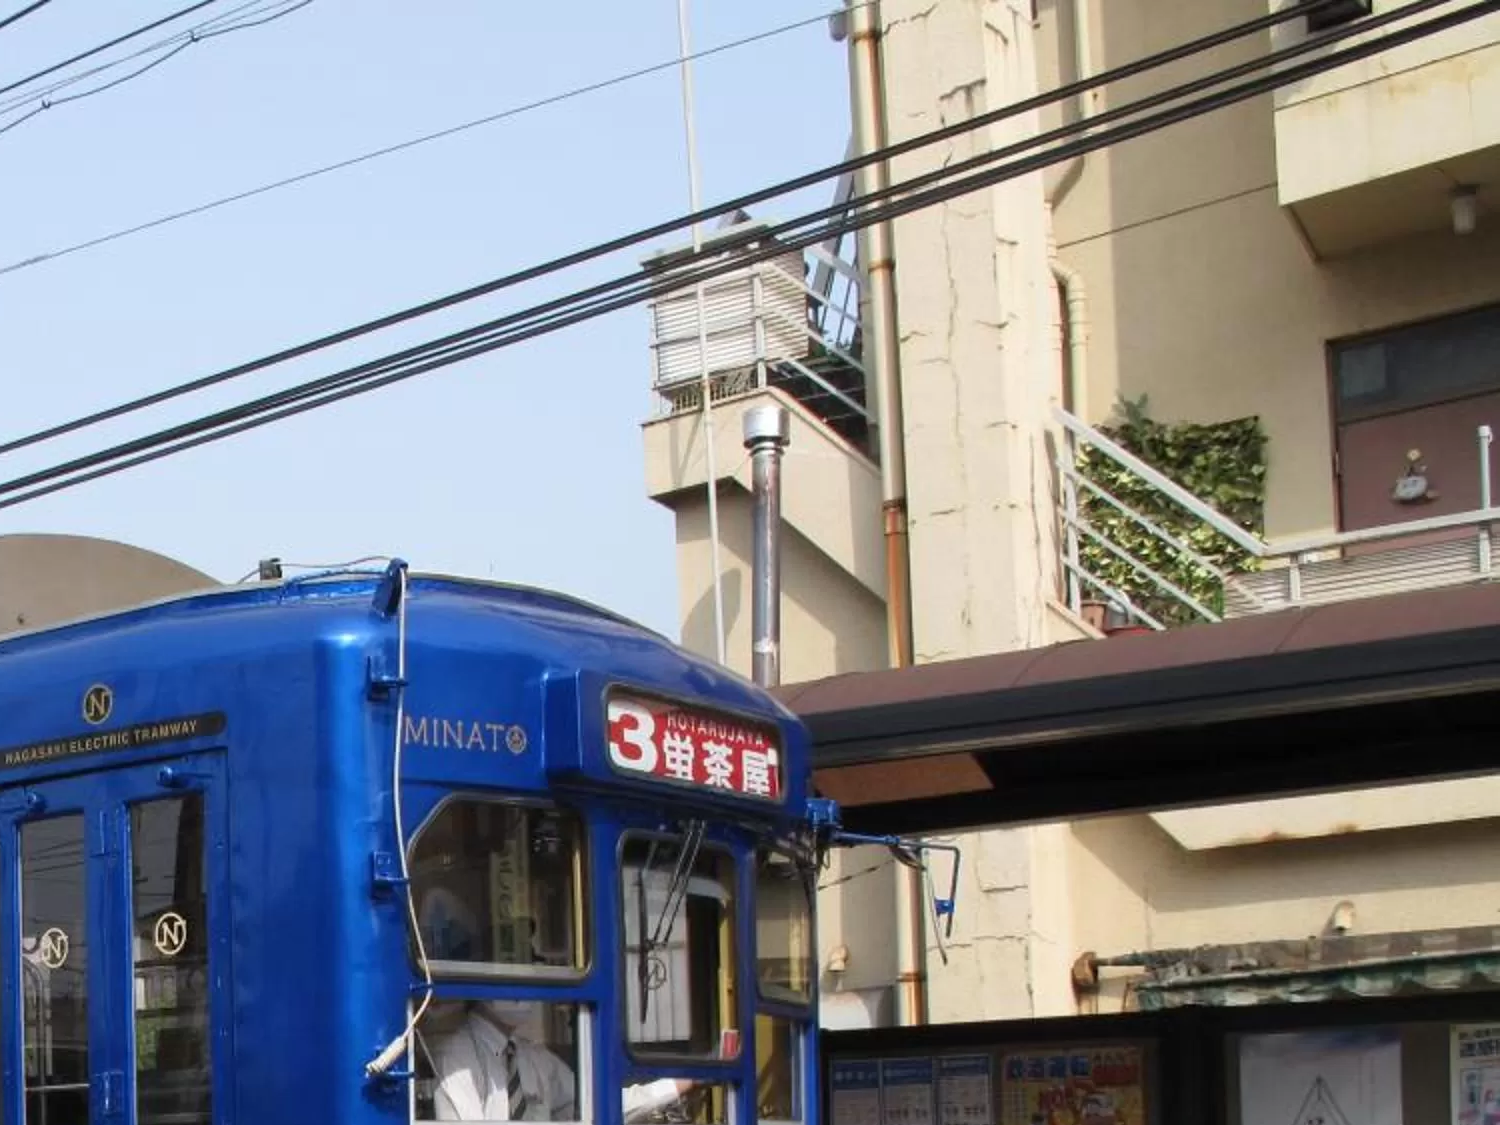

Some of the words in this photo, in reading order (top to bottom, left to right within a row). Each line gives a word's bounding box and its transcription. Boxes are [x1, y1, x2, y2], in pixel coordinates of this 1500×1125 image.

[6, 746, 66, 765] NAGASAKI
[70, 731, 129, 753] ELECTRIC
[134, 719, 198, 742] TRAMWAY
[404, 716, 527, 754] MINATO
[608, 700, 658, 772] 3
[668, 712, 765, 746] HOTARUJAYA
[663, 731, 772, 797] 蛍茶屋
